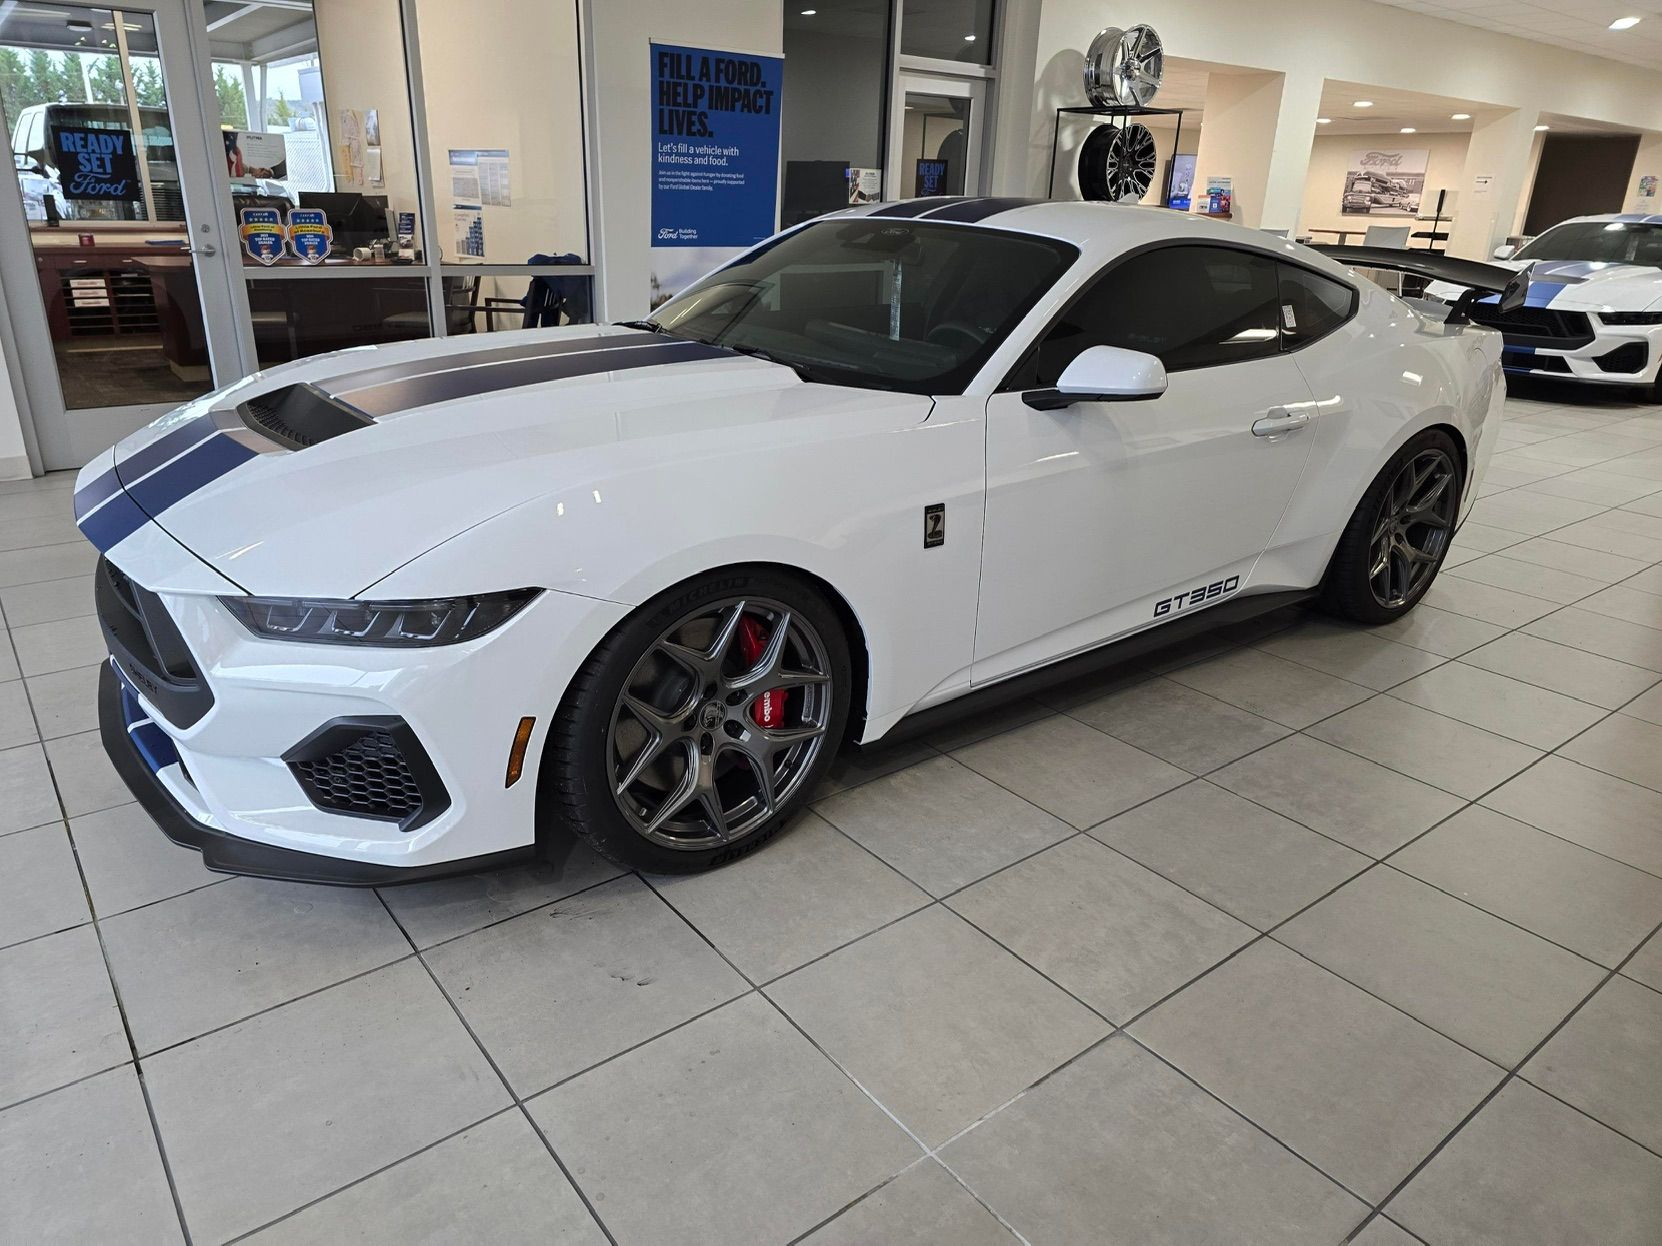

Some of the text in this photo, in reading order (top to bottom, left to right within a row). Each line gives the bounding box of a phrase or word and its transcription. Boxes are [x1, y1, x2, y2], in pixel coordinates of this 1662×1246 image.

[658, 51, 766, 88] FILL A FORD.
[659, 80, 774, 114] HELP IMPACT
[658, 108, 714, 138] LIVES.
[60, 132, 124, 155] READY
[658, 142, 677, 153] Let's
[678, 143, 688, 153] fill
[696, 145, 722, 155] vehicle
[723, 146, 739, 156] with
[78, 153, 112, 173] SET
[658, 153, 728, 166] kindness and food.
[920, 163, 945, 176] READY
[1360, 152, 1403, 167] Ford
[70, 172, 126, 195] Ford
[924, 175, 938, 187] SET
[658, 228, 678, 239] Ford
[1154, 574, 1240, 617] GT350
[764, 692, 772, 722] embo
